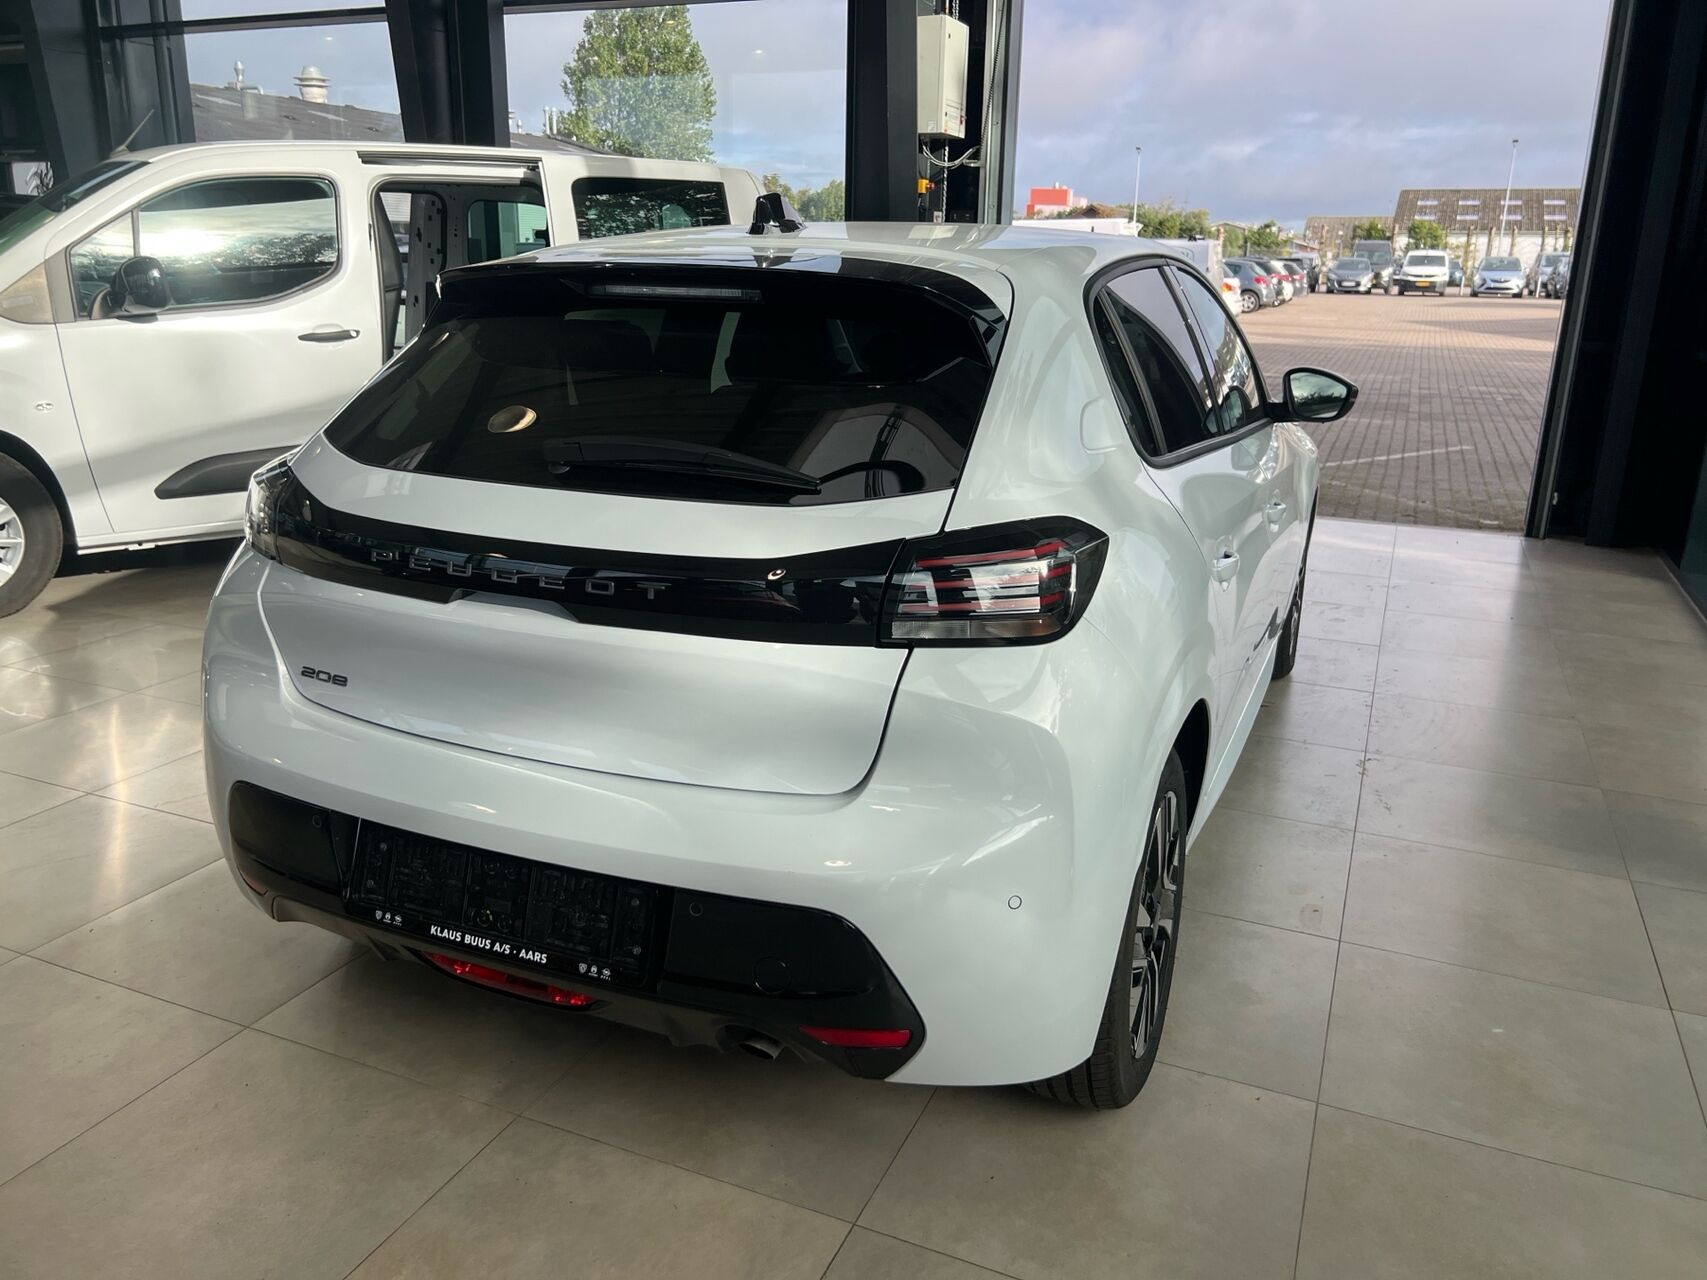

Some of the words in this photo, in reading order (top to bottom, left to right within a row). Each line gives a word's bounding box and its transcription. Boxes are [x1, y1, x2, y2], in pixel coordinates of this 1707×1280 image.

[370, 548, 672, 600] PEUGEOT
[301, 665, 348, 687] 208
[430, 925, 461, 942] KLAUS
[464, 934, 491, 950] BUUS
[493, 942, 511, 955] A/S
[519, 948, 548, 964] AARS
